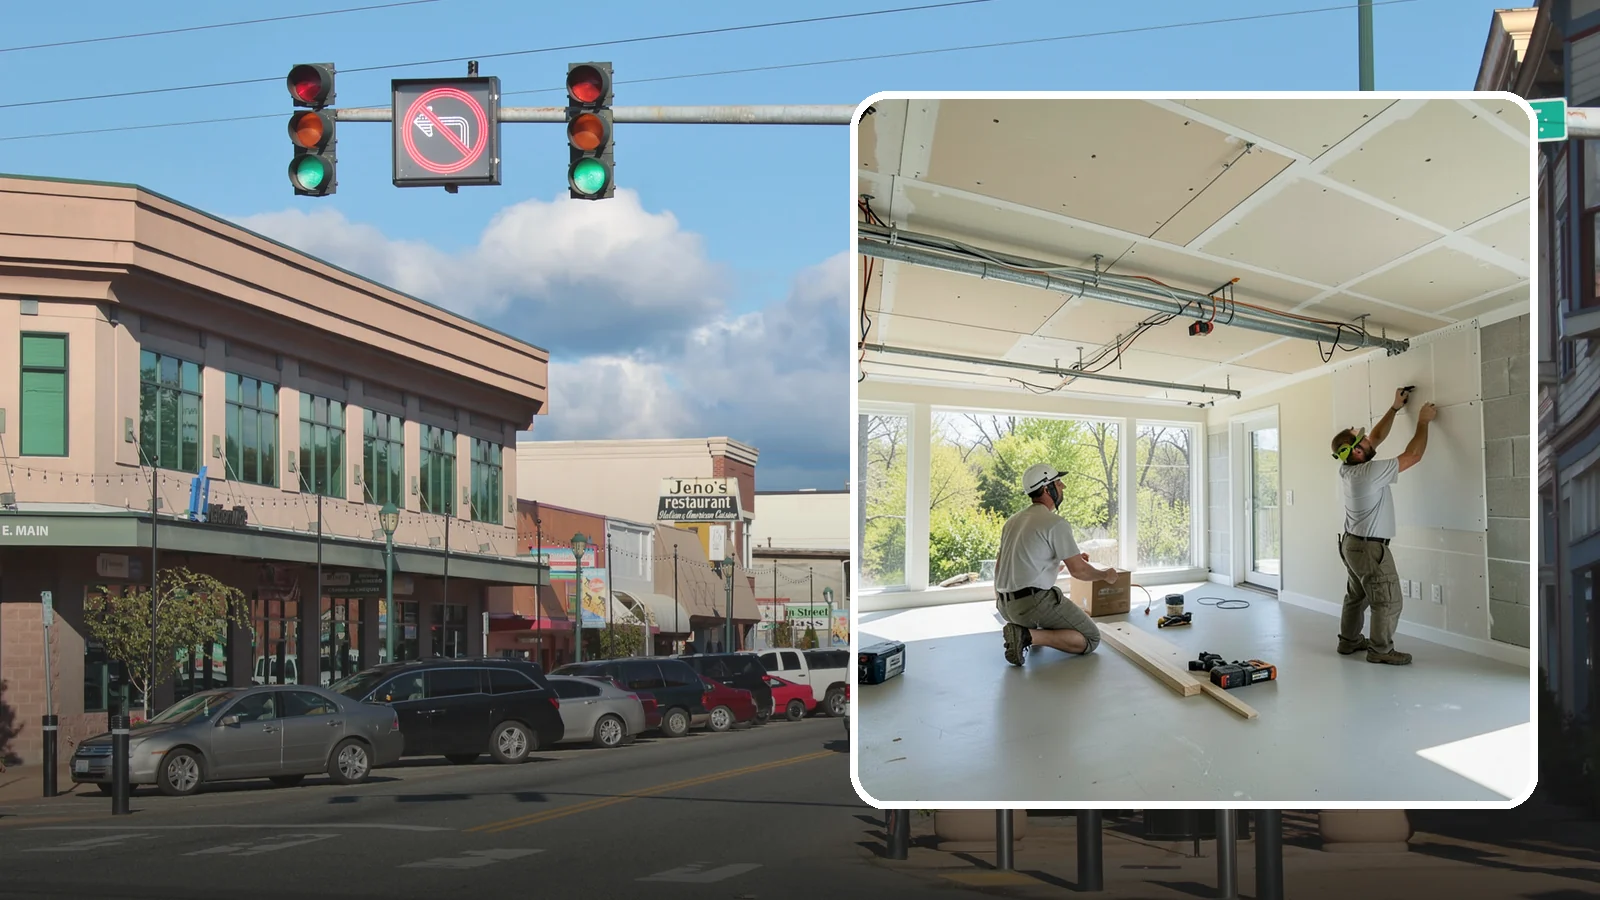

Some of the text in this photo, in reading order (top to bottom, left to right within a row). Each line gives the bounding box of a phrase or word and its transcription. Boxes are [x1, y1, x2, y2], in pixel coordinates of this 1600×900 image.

[669, 480, 727, 494] Jeno's
[665, 496, 731, 509] restaurant
[659, 510, 681, 519] Italian
[686, 510, 714, 519] American
[715, 509, 737, 519] Cuisine
[2, 525, 49, 536] E. MAIN
[797, 608, 828, 616] Street
